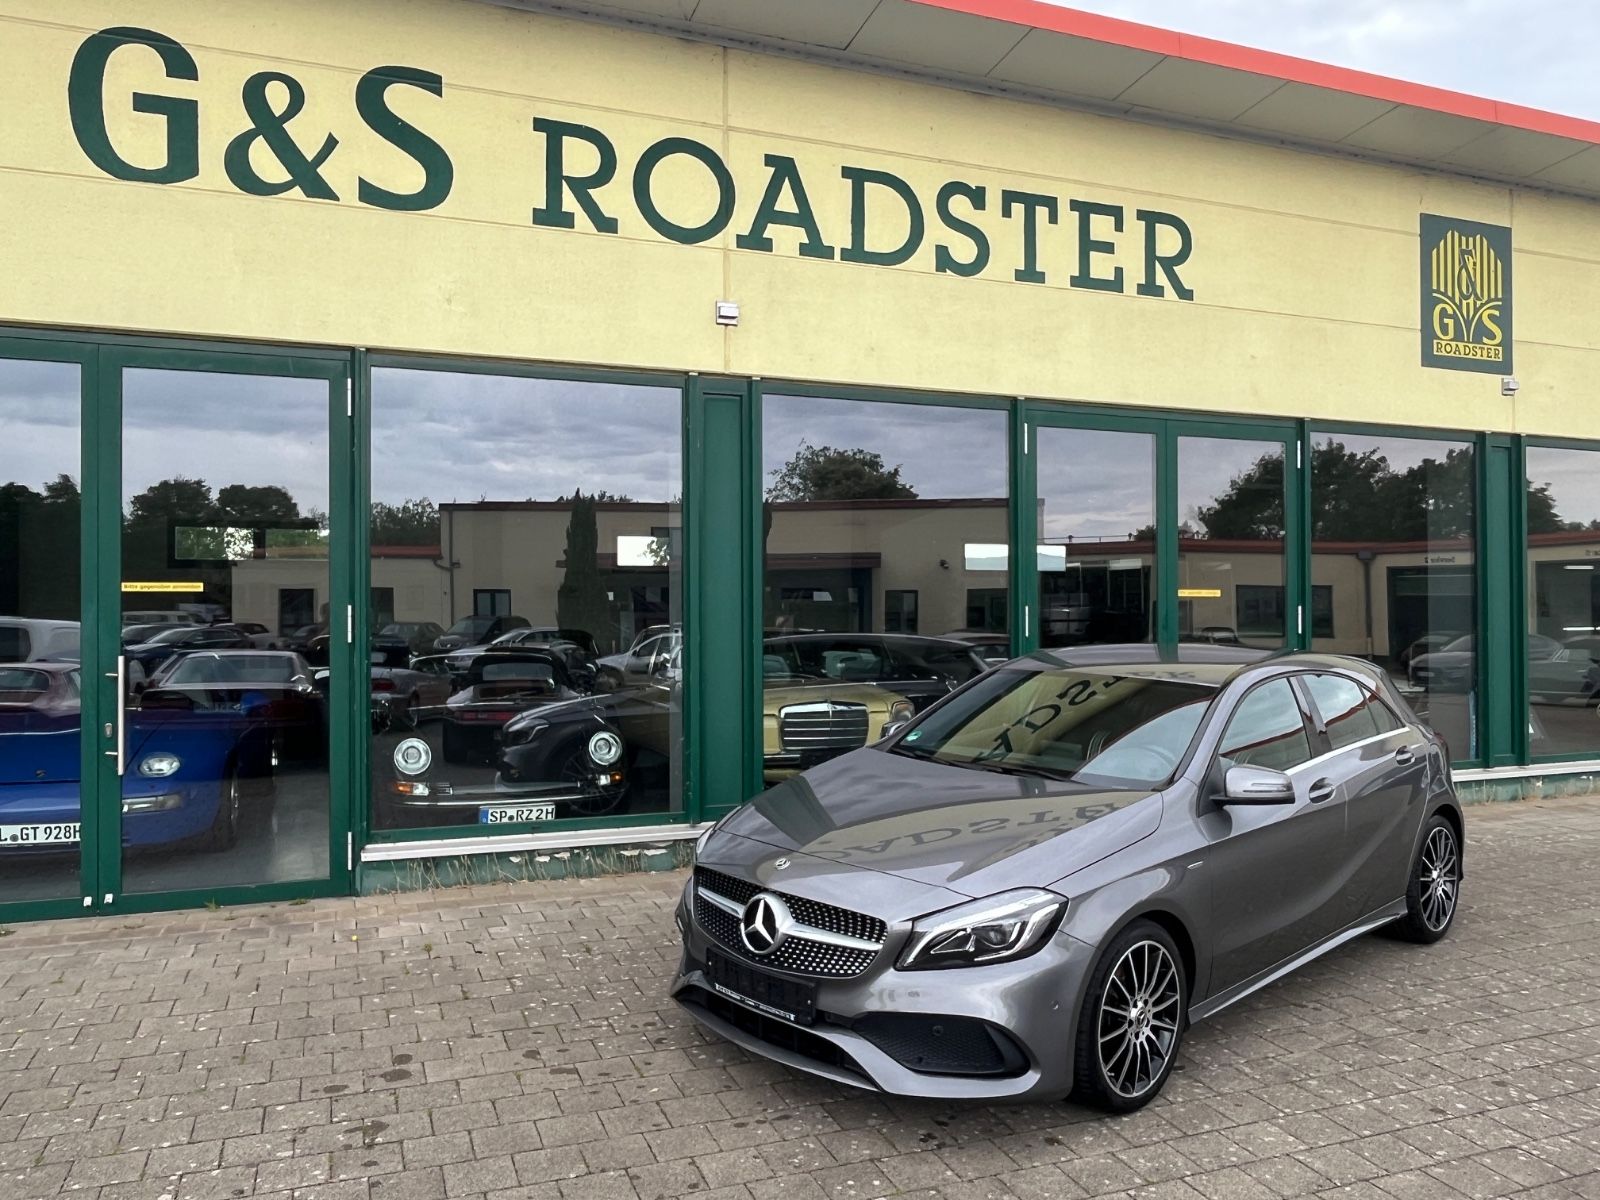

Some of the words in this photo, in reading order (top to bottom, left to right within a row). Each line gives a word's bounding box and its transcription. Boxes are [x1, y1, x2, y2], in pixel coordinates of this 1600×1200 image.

[68, 26, 454, 211] G&S
[532, 117, 1194, 300] ROADSTER
[1433, 303, 1455, 340] G
[1482, 309, 1503, 346] S
[1436, 343, 1501, 359] ROADSTER
[490, 810, 508, 822] SP
[20, 826, 40, 841] GT
